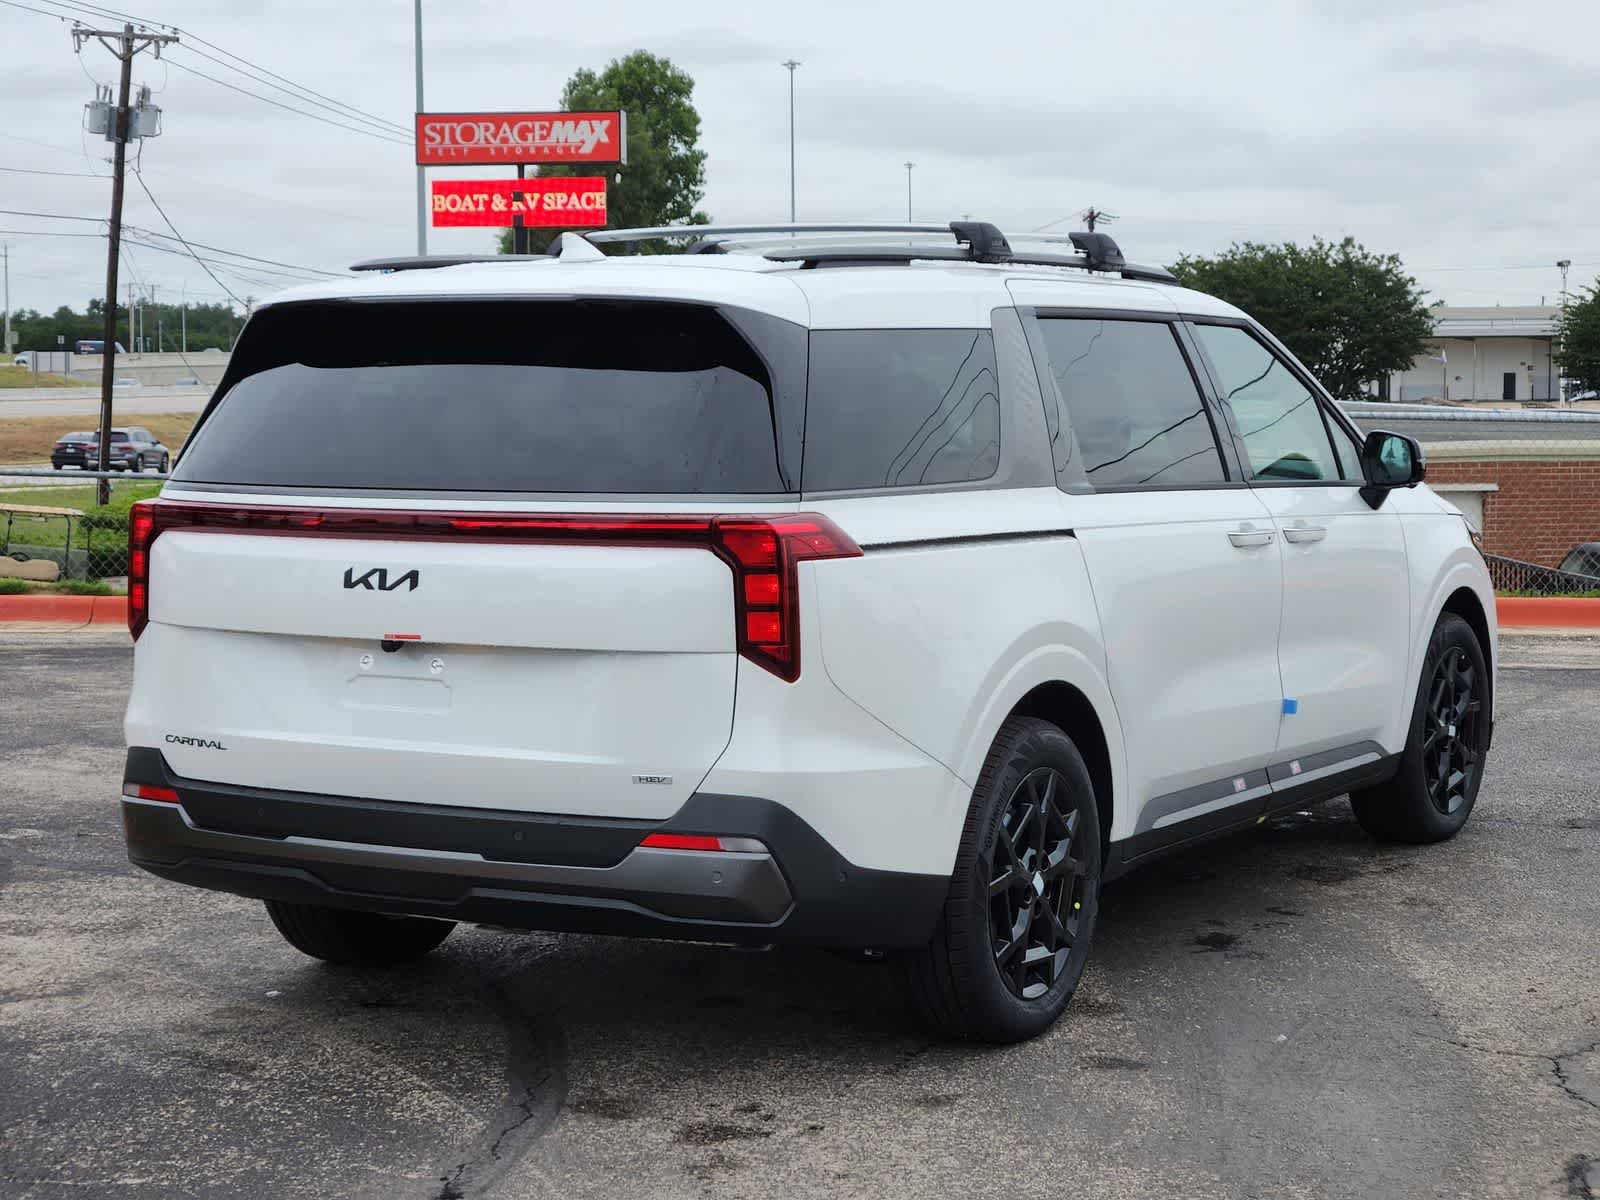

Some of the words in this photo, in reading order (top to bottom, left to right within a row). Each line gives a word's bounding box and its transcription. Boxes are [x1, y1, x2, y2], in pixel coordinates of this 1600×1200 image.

[432, 193, 489, 213] BOAT
[491, 193, 508, 212] &
[543, 191, 606, 210] SPACE
[343, 567, 419, 592] KIA
[165, 734, 228, 751] CARNIVAL
